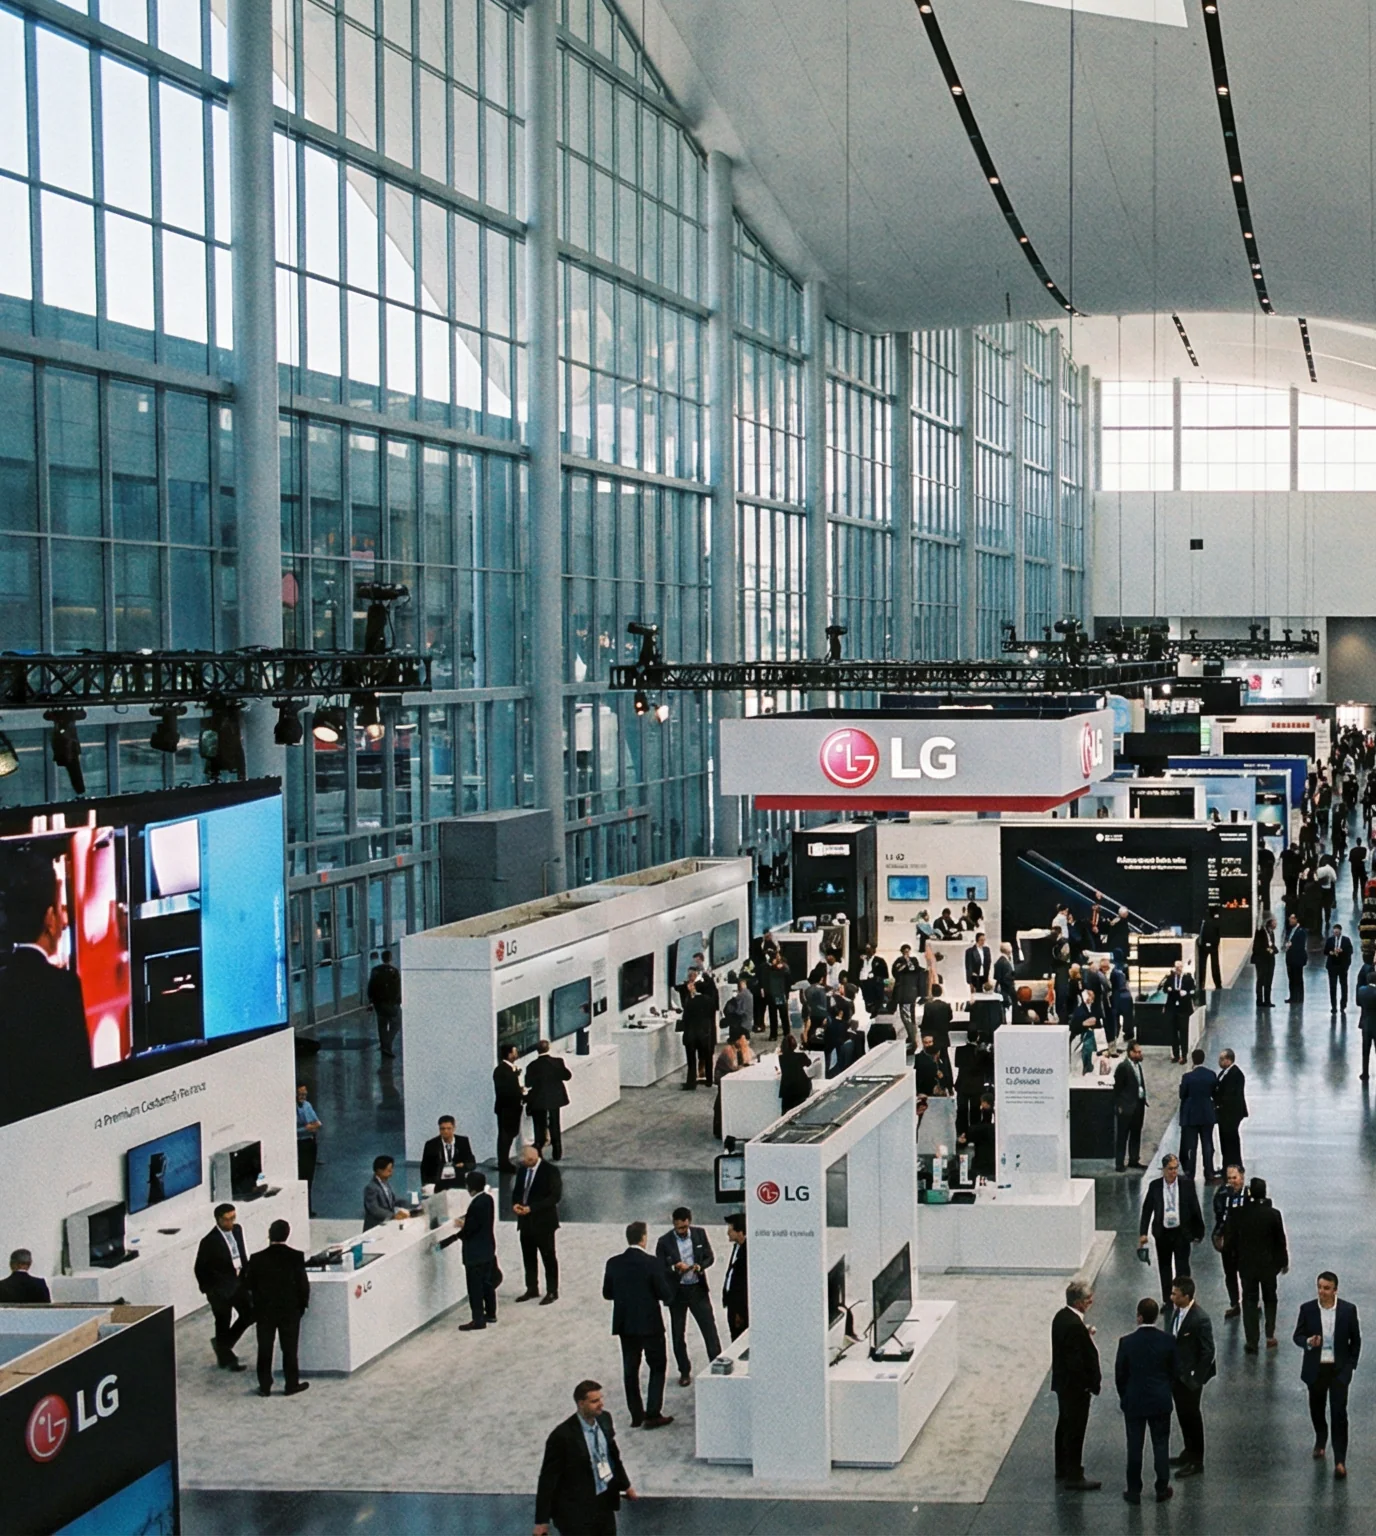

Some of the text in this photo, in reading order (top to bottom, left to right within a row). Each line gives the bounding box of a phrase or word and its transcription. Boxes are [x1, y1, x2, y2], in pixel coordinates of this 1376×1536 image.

[891, 737, 957, 779] LG
[506, 940, 518, 957] LG
[784, 1185, 810, 1201] LG
[76, 1374, 120, 1433] LG
